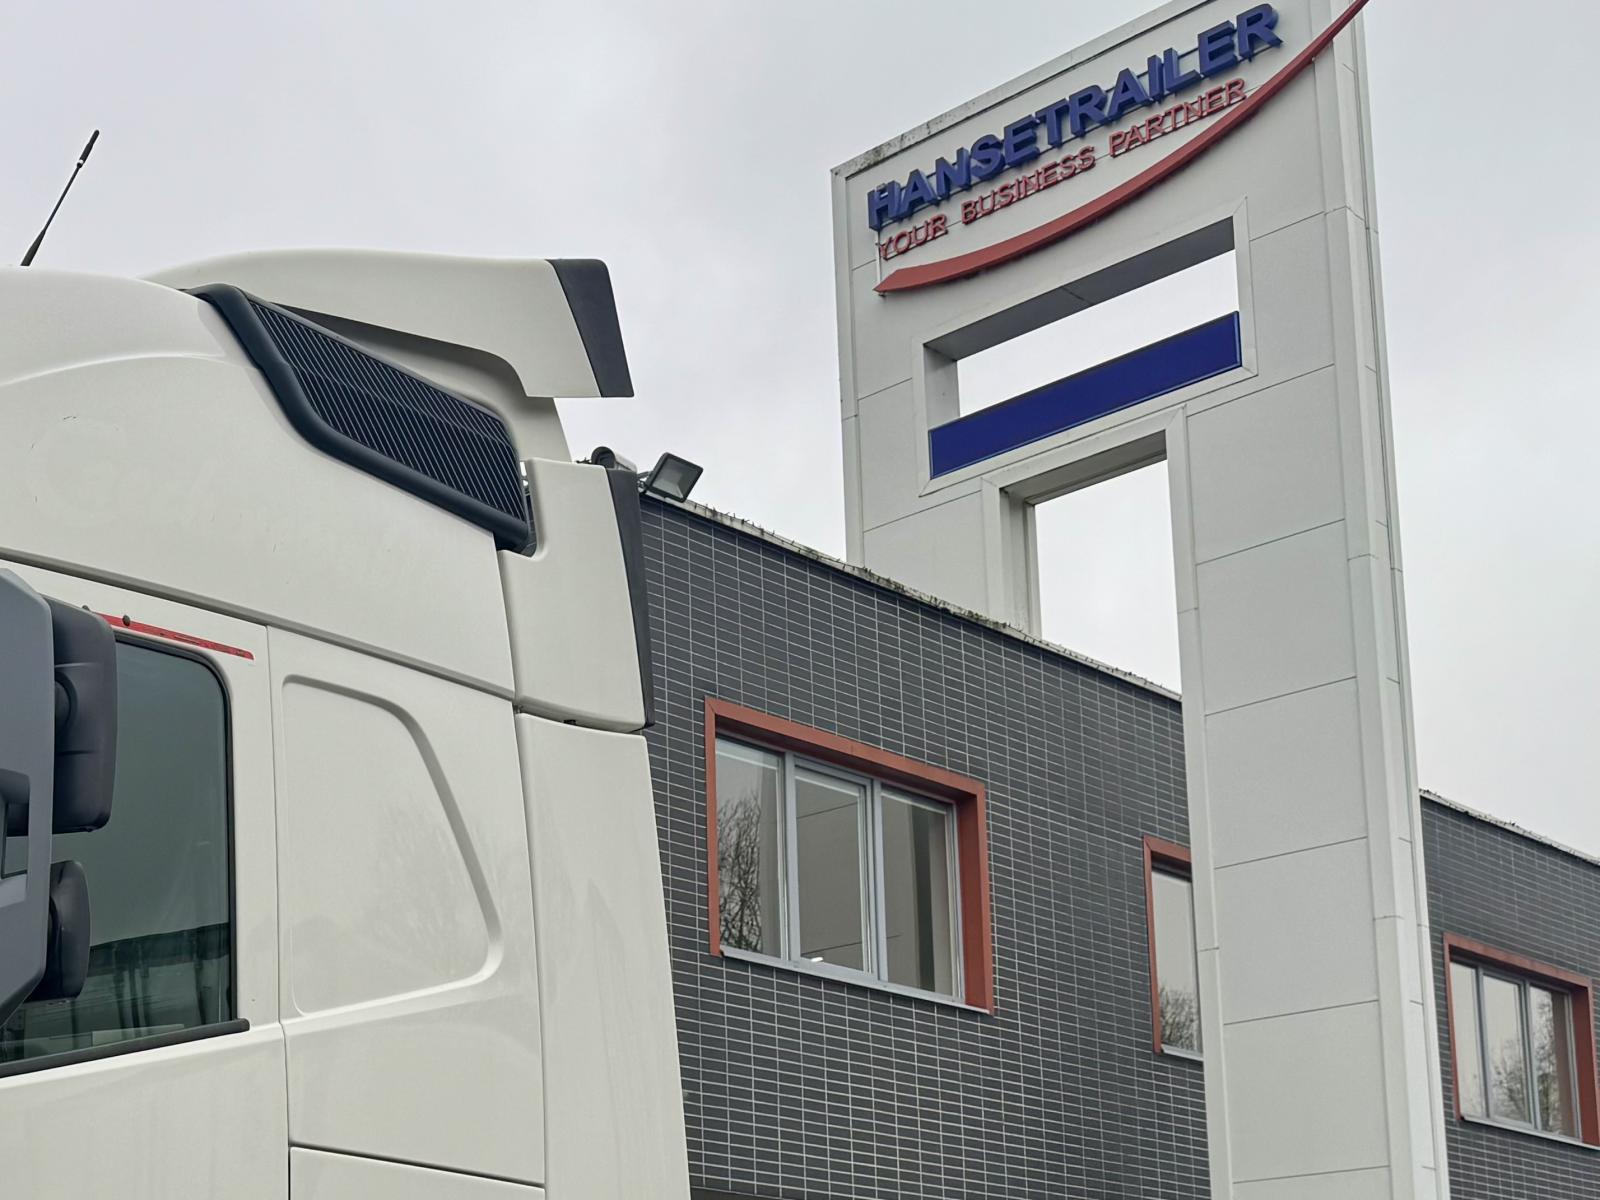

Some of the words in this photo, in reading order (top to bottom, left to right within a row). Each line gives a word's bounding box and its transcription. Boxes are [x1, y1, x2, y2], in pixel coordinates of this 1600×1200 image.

[867, 3, 1285, 231] HANSETRAILER
[879, 213, 949, 261] YOUR
[960, 145, 1097, 226] BUSINESS
[1107, 77, 1248, 159] PARTNER
